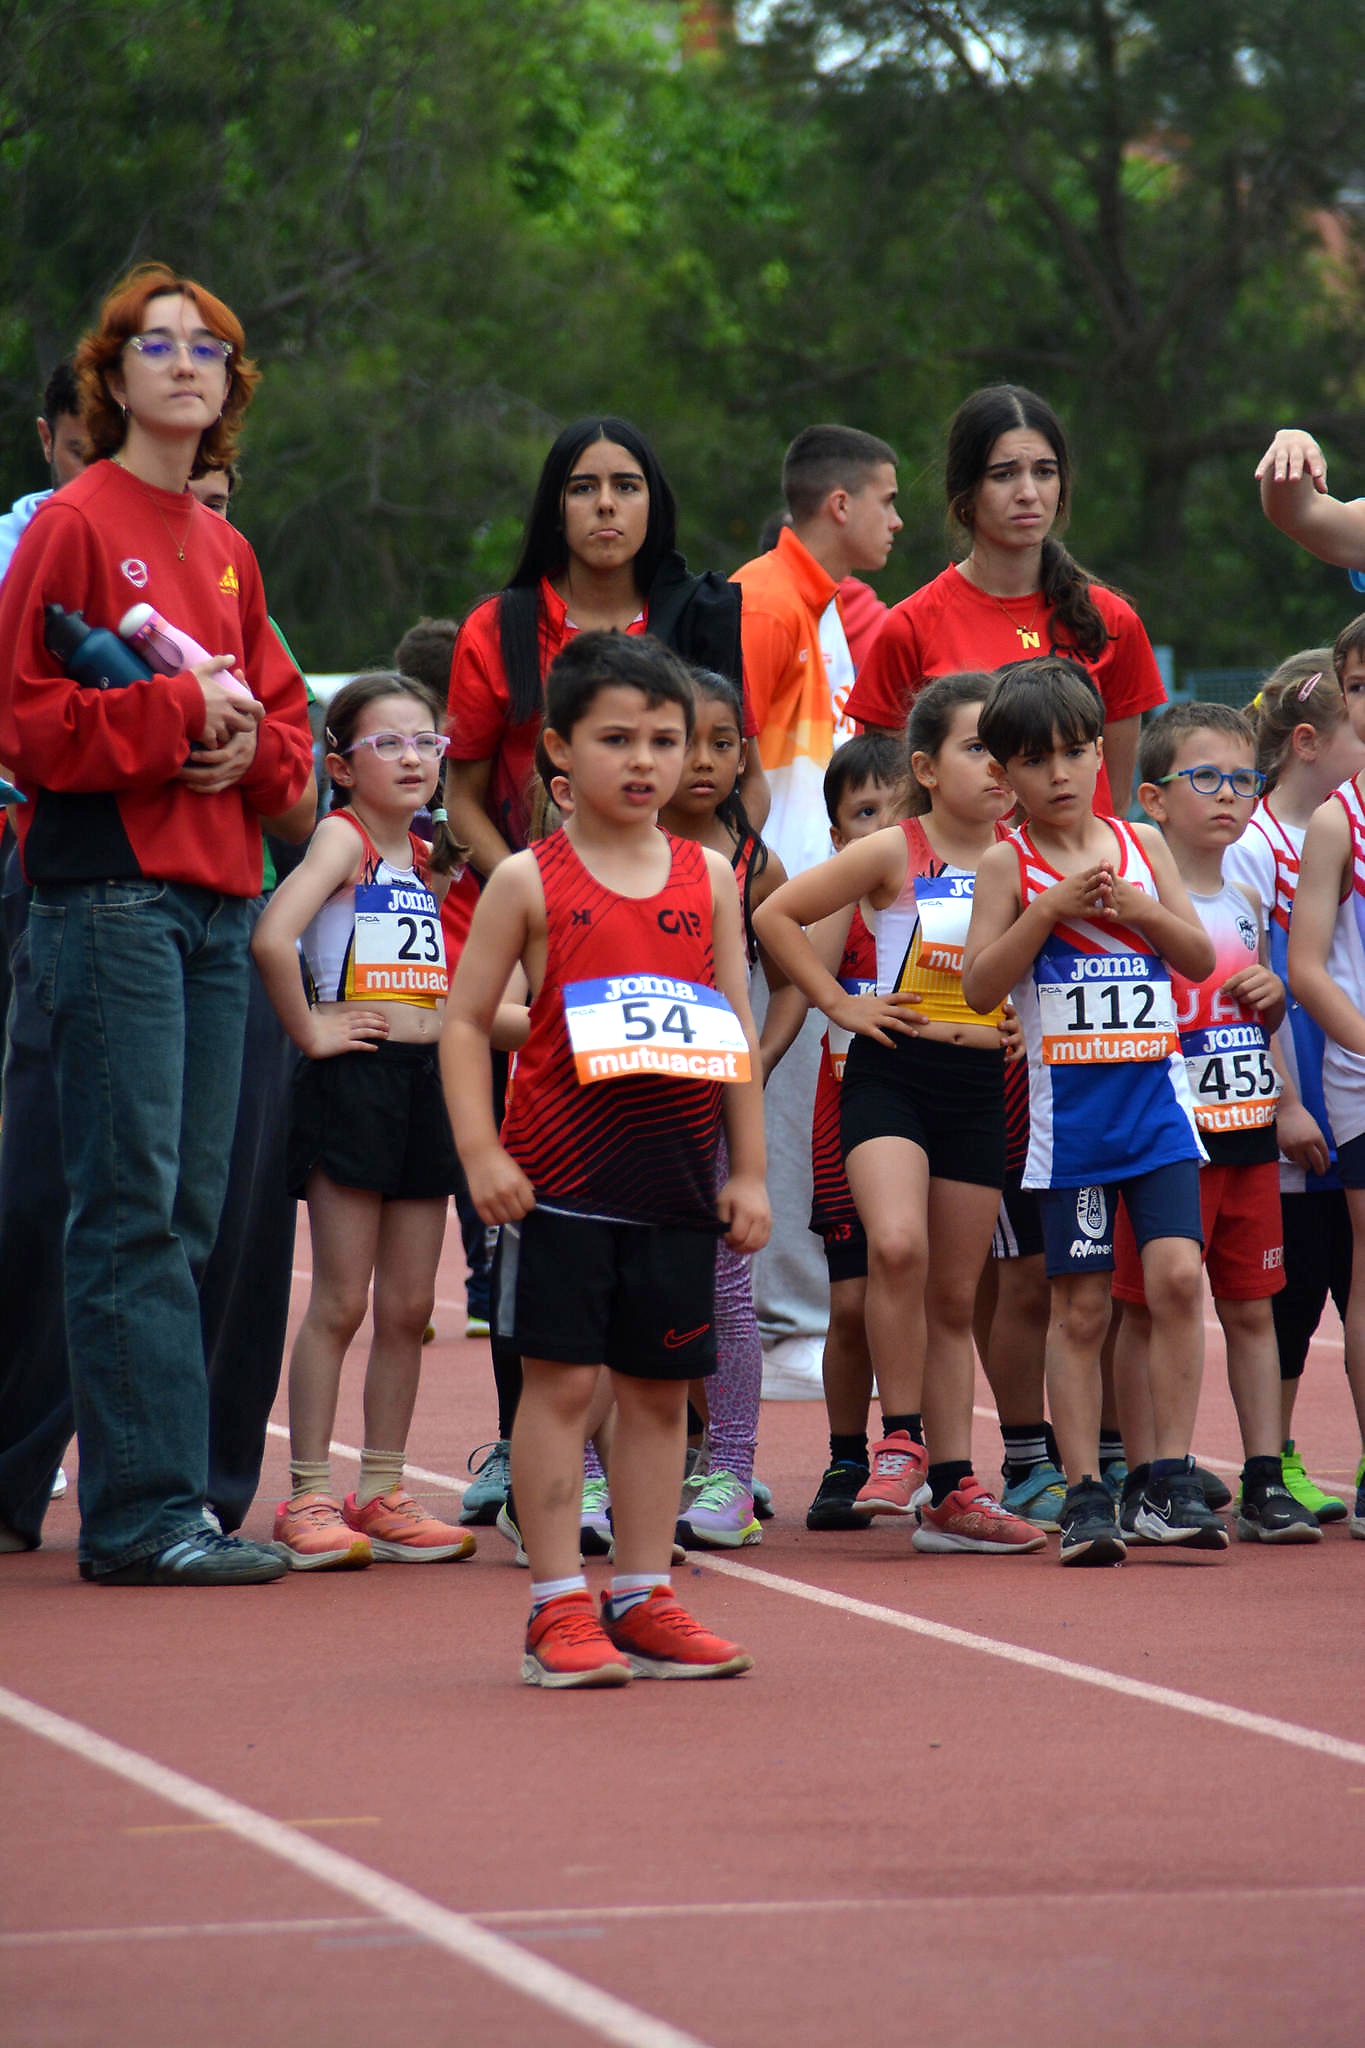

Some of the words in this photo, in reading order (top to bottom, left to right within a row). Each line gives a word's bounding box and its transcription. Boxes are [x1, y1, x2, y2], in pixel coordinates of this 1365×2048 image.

[397, 916, 441, 963] 23
[621, 1000, 698, 1044] 54
[1065, 984, 1157, 1031] 112
[588, 1046, 739, 1079] mutuacat
[1051, 1035, 1169, 1061] mutuacat
[1198, 1052, 1276, 1101] 455
